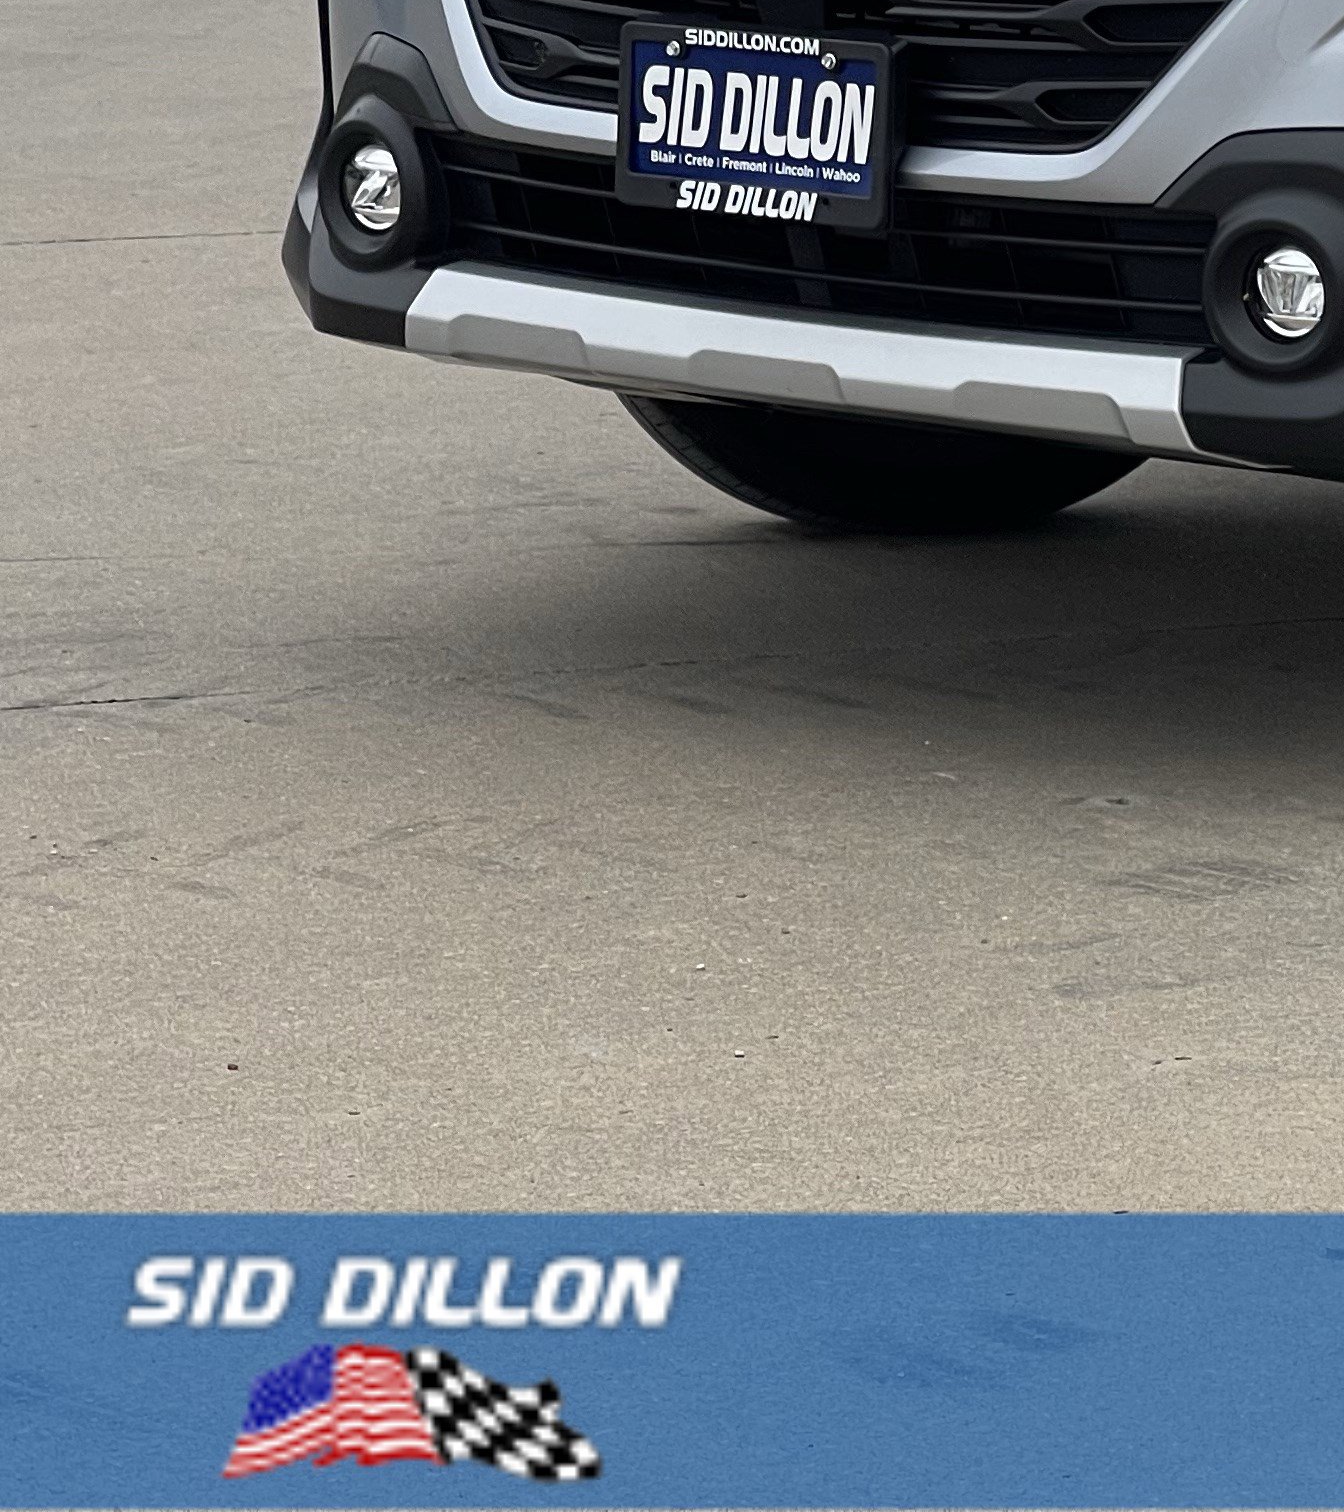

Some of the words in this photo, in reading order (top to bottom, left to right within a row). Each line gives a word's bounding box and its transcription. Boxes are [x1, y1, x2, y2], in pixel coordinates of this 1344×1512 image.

[684, 29, 820, 56] SIDDILLON.COM
[638, 64, 714, 148] SID
[719, 71, 875, 165] DILLON
[650, 149, 676, 164] Blair
[684, 153, 714, 168] Crete
[722, 156, 767, 174] Fremont
[775, 162, 814, 179] Lincoln
[822, 167, 861, 184] Wahoo
[676, 180, 721, 211] SID
[724, 183, 818, 222] DILLON
